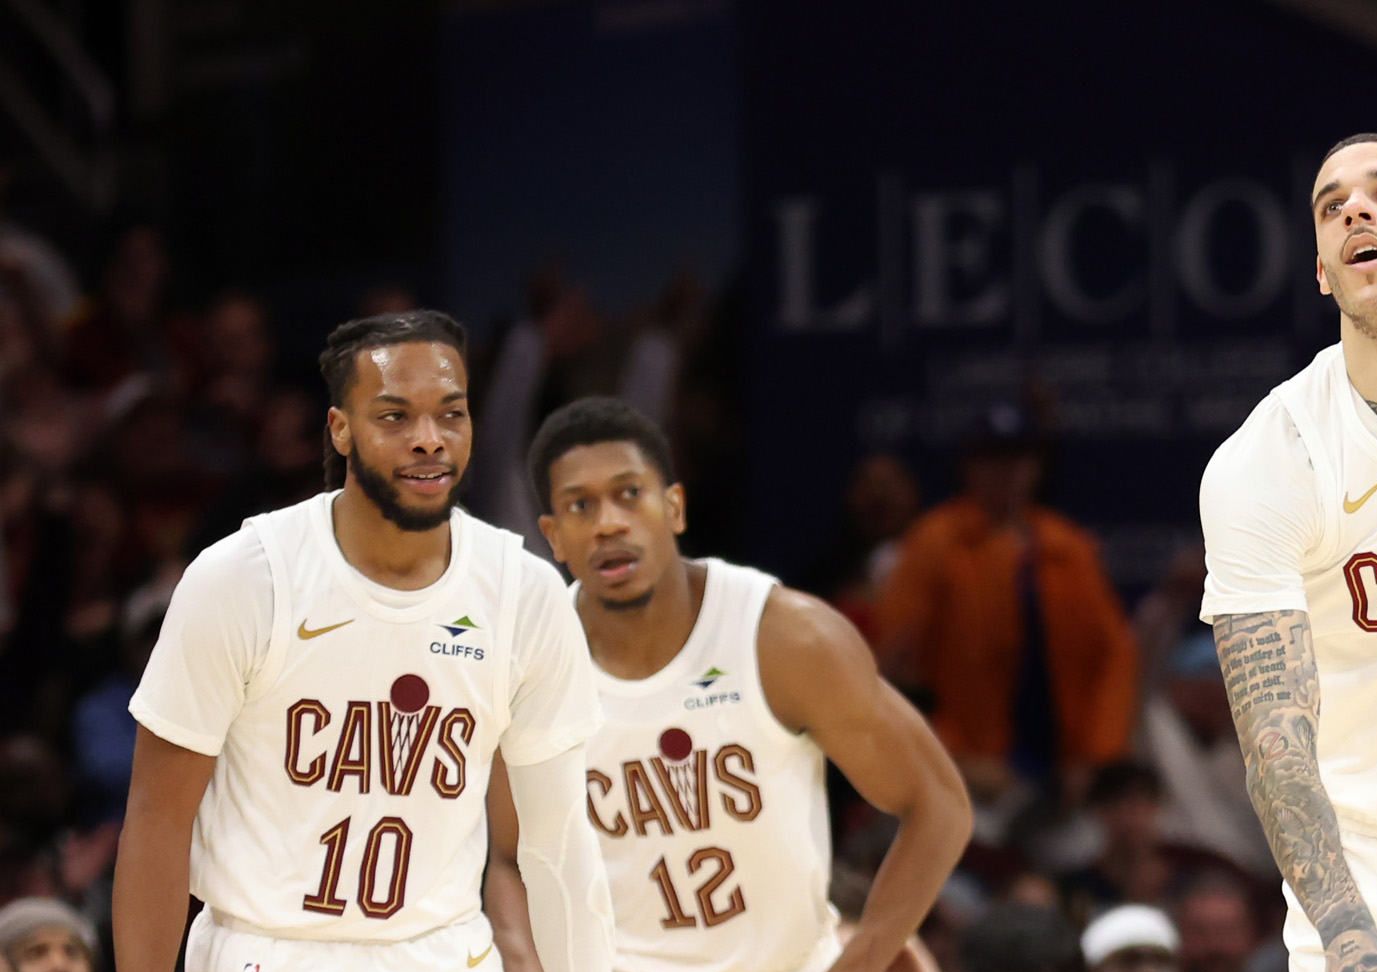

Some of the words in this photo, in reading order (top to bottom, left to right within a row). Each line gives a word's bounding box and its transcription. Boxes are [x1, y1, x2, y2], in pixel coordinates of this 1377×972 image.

[768, 176, 1340, 334] LECO
[429, 641, 485, 661] CLIFFS
[284, 698, 476, 800] CAVS
[586, 743, 763, 839] CAVS
[302, 815, 414, 920] 10
[649, 846, 747, 930] 12
